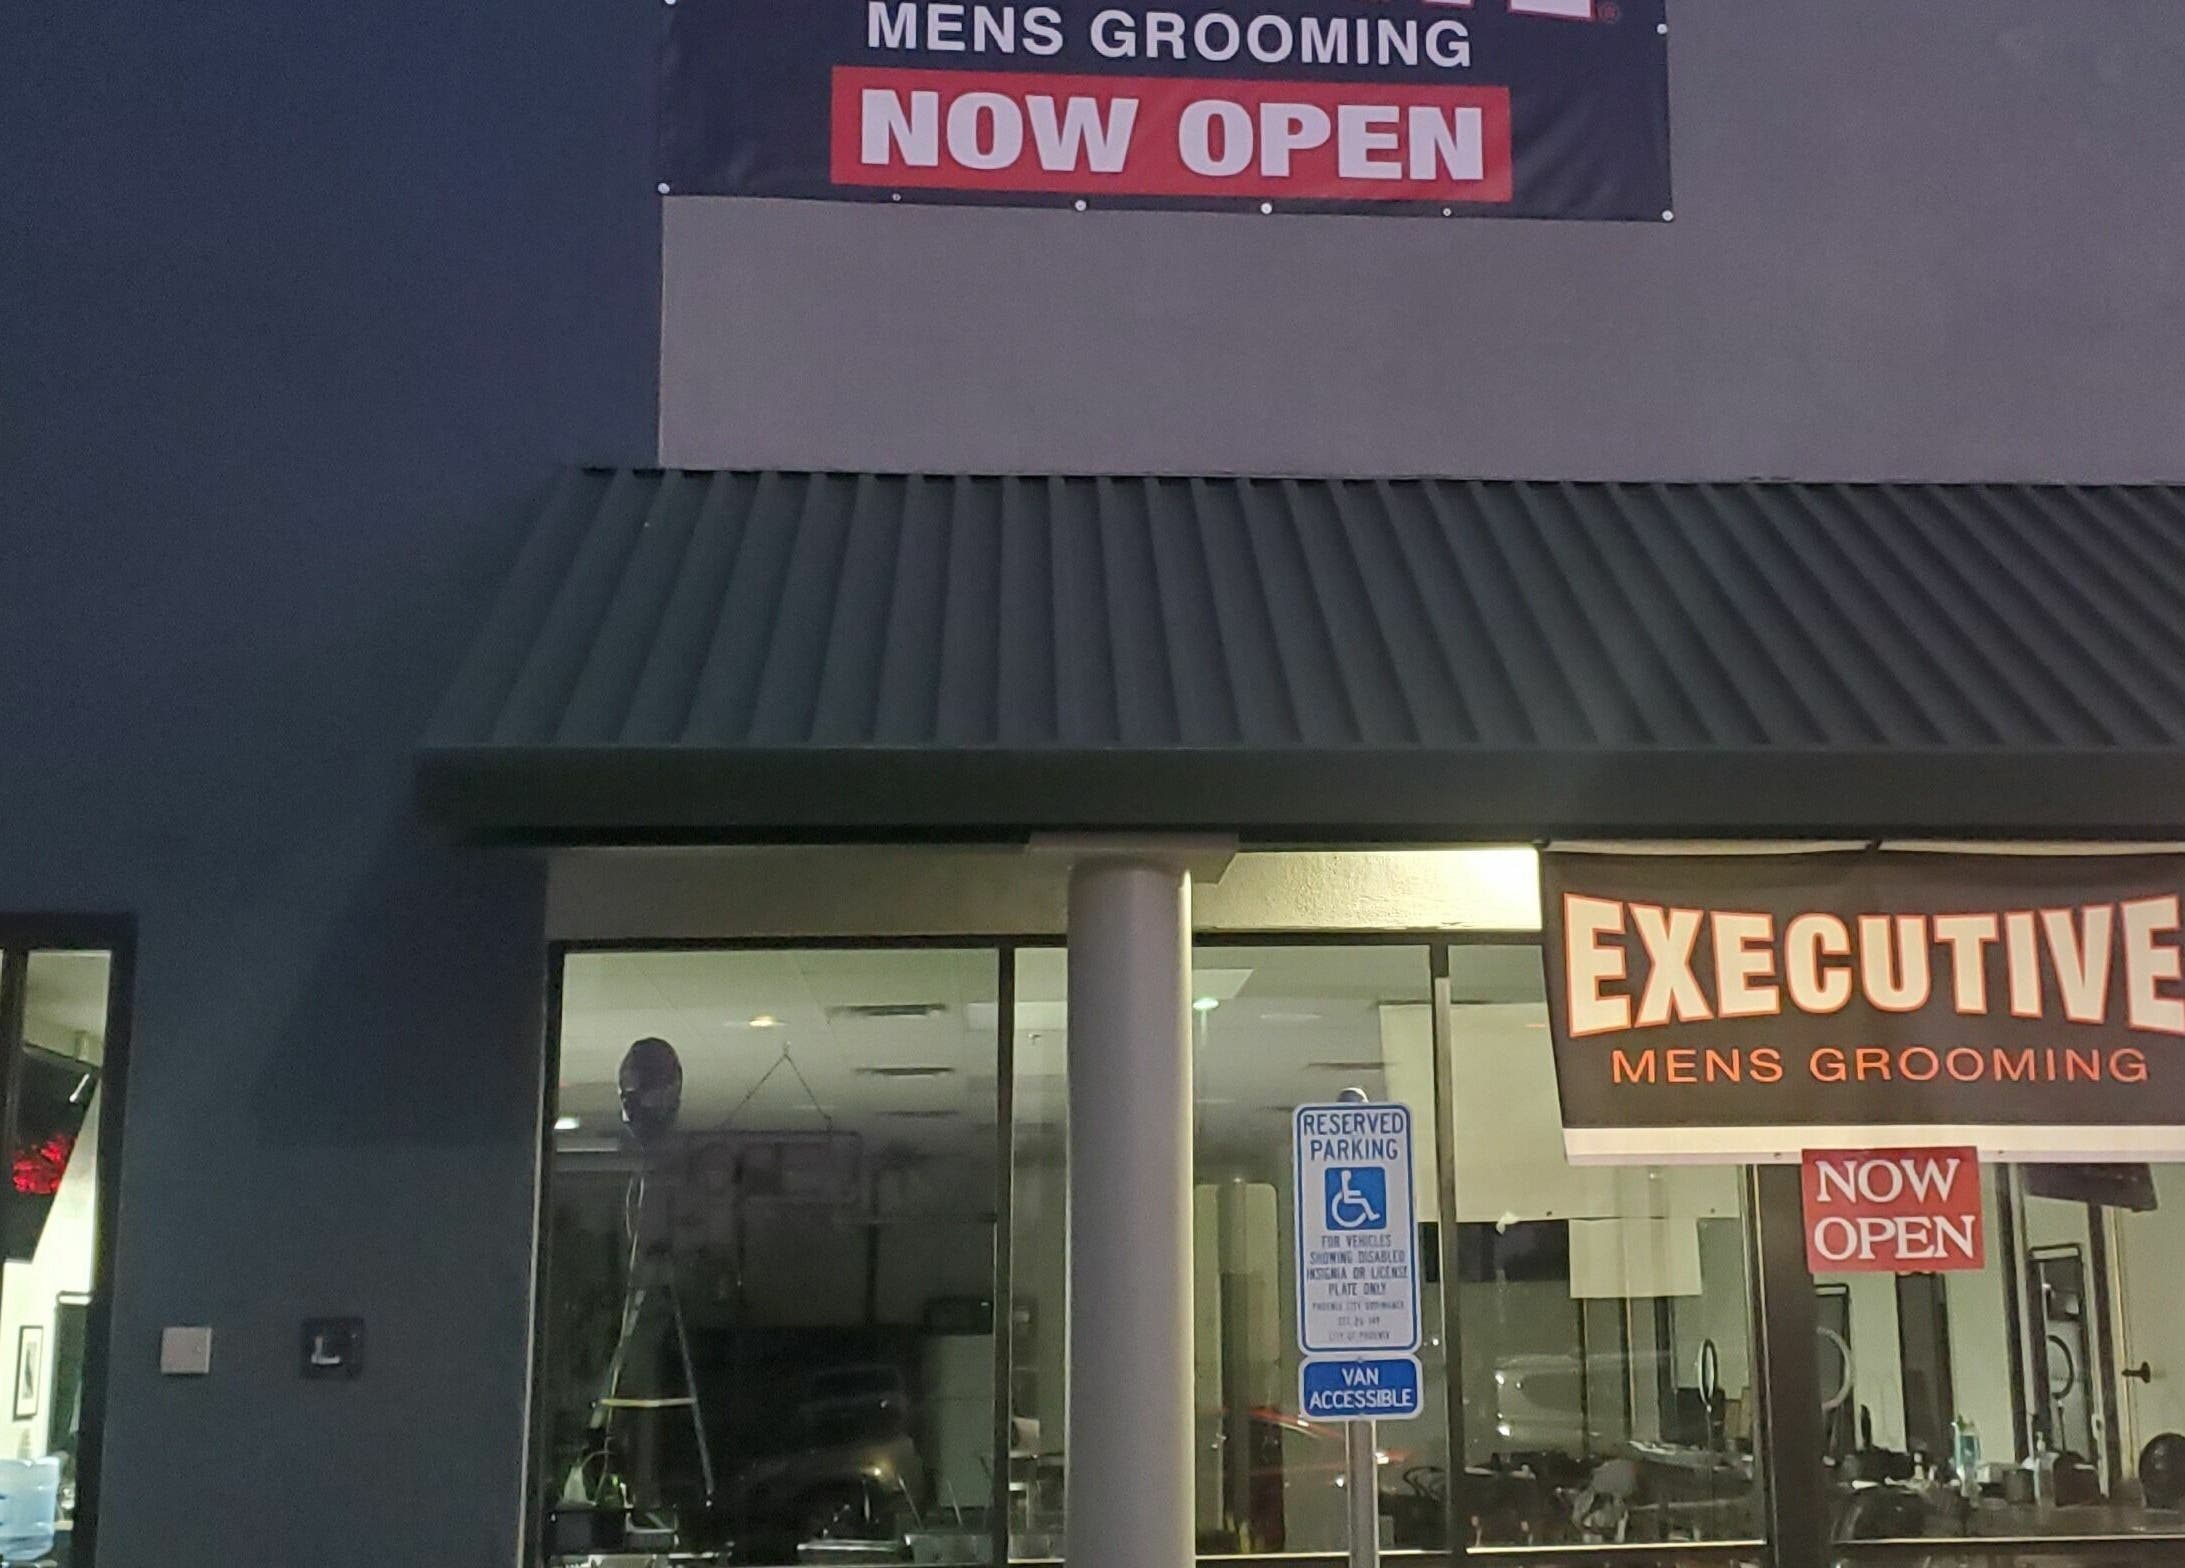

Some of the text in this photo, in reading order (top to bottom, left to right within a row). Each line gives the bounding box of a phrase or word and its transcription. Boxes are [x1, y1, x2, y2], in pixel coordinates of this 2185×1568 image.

[867, 1, 1471, 68] MENS GROOMING
[861, 88, 1484, 181] NOW OPEN
[1563, 892, 2185, 1037] EXECUTIVE
[1611, 1046, 2150, 1085] MENS GROOMING
[1303, 1112, 1404, 1136] RESERVED
[1310, 1138, 1399, 1161] PARKING
[1815, 1157, 1960, 1203] NOW
[1321, 1234, 1392, 1248] FOR VEHICLES
[1813, 1214, 1976, 1260] OPEN
[1310, 1249, 1405, 1265] SHOWING DISABLED
[1307, 1265, 1408, 1280] INSIGNIA OR LICENSE
[1328, 1282, 1387, 1296] PLATE ONLY
[1341, 1367, 1379, 1386] VAN
[1309, 1388, 1413, 1409] ACCESSIBLE
